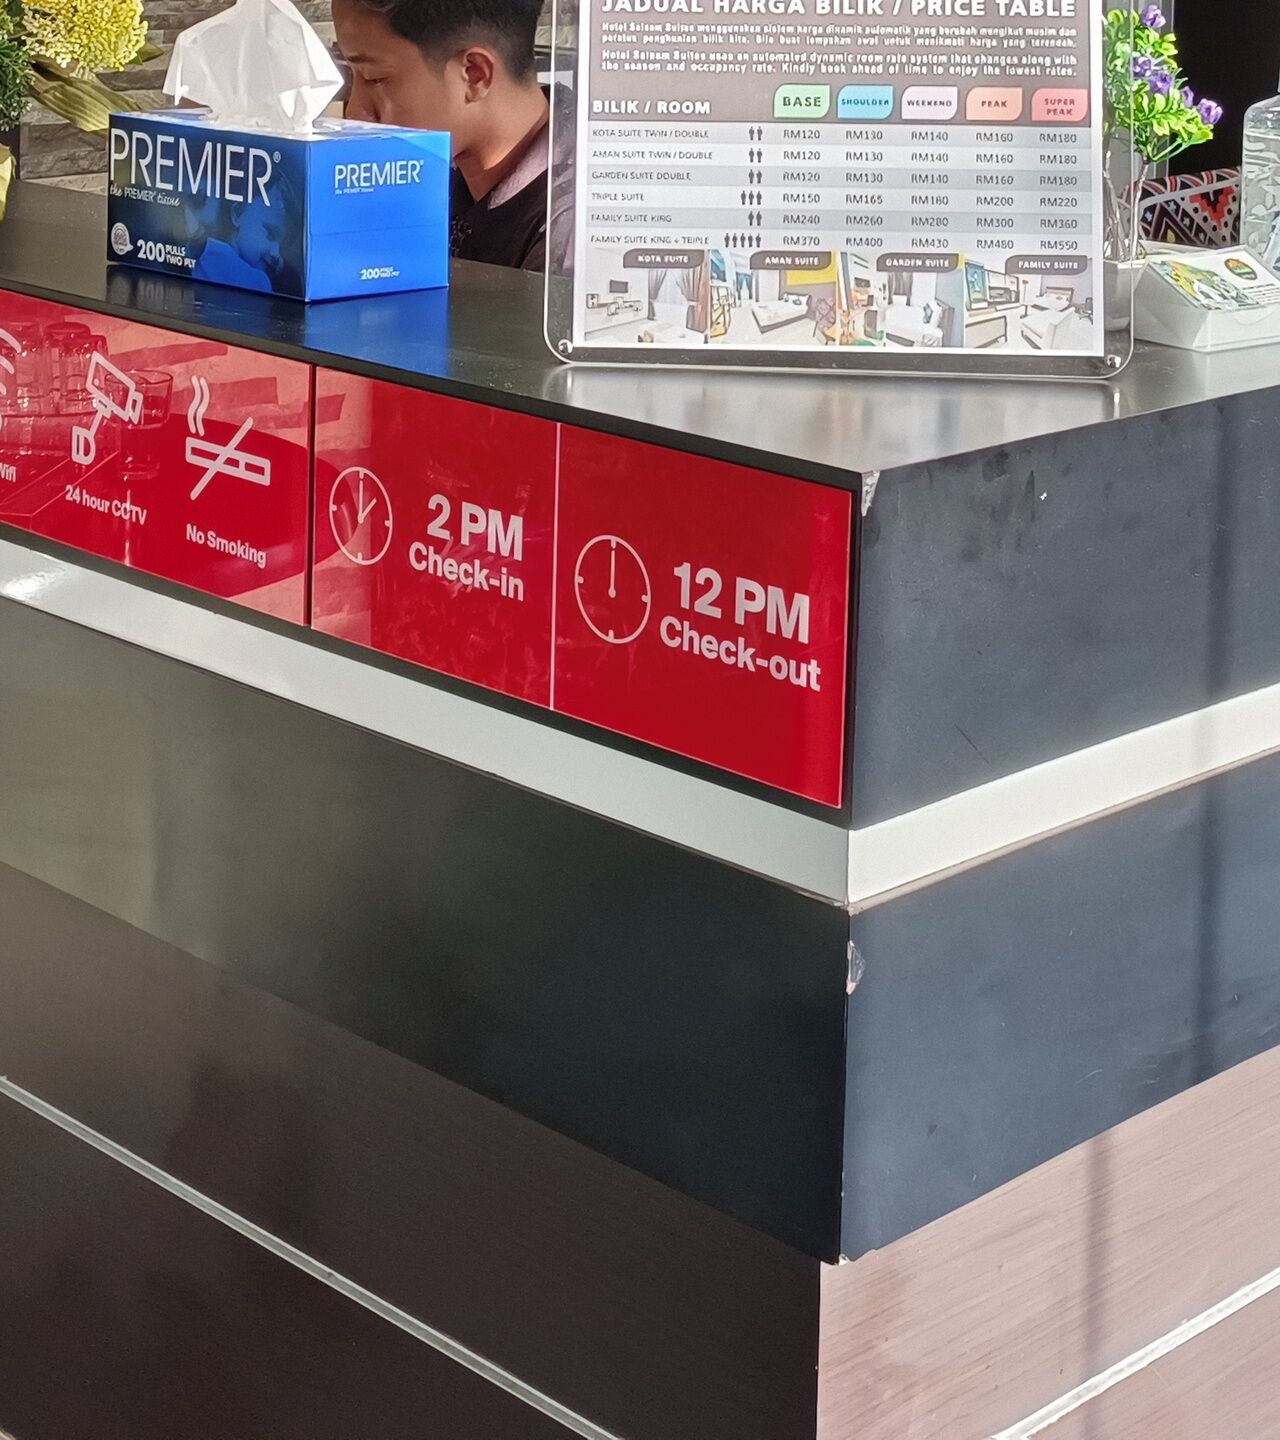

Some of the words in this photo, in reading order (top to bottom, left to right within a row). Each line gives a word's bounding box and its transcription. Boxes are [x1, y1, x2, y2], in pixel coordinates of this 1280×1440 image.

[913, 27, 936, 37] yang
[1058, 26, 1076, 36] dan
[970, 37, 998, 48] harga
[1002, 39, 1026, 48] yang
[810, 52, 853, 64] dynamic
[856, 54, 883, 62] room
[886, 53, 906, 63] rate
[910, 53, 947, 65] system
[950, 54, 972, 63] that
[974, 54, 1018, 66] changes
[1022, 55, 1051, 66] along
[1054, 55, 1077, 64] with
[666, 63, 685, 72] and
[690, 65, 746, 74] occupancy
[782, 64, 815, 75] Kindly
[852, 65, 883, 74] ahead
[888, 65, 900, 74] of
[904, 65, 926, 74] time
[932, 65, 944, 74] to
[948, 67, 978, 76] enjoy
[983, 66, 1000, 75] the
[1006, 66, 1040, 75] lowest
[592, 100, 639, 114] BILIK
[657, 101, 711, 114] ROOM
[783, 96, 822, 107] BASE
[841, 98, 889, 106] SHOULDER
[981, 100, 1007, 108] PEAK
[1044, 98, 1075, 106] SUPER
[1046, 108, 1073, 116] PEAK
[592, 129, 616, 137] KOTA
[645, 129, 667, 138] TWIN
[674, 130, 709, 138] DOUBLE
[784, 130, 820, 139] RM120
[911, 132, 948, 142] RM140
[976, 133, 1014, 142] RM160
[1039, 134, 1078, 143] RM180
[622, 151, 646, 159] SUITE
[649, 151, 671, 159] TWIN
[678, 151, 713, 160] DOUBLE
[784, 151, 820, 160] RM120
[846, 152, 883, 162] RM130
[911, 154, 948, 162] RM140
[976, 154, 1014, 164] RM160
[1039, 155, 1078, 164] RM180
[591, 171, 628, 179] GARDEN
[630, 171, 654, 180] SUITE
[976, 176, 1014, 186] RM160
[1039, 176, 1078, 186] RM180
[620, 193, 644, 201] SUITE
[846, 195, 883, 204] RM165
[976, 197, 1014, 206] RM200
[1039, 198, 1078, 208] RM220
[590, 214, 622, 222] FAMILY
[624, 214, 648, 223] SUITE
[784, 215, 820, 224] RM240
[846, 216, 883, 226] RM260
[976, 218, 1014, 228] RM300
[1039, 220, 1078, 228] RM360
[590, 236, 621, 244] FAMILY
[624, 236, 648, 244] SUITE
[650, 236, 671, 244] KING
[784, 236, 820, 246] RM370
[846, 238, 883, 248] RM400
[911, 239, 948, 248] RM430
[976, 240, 1014, 250] RM480
[1039, 241, 1078, 250] RM550
[137, 239, 165, 262] 200
[165, 245, 186, 256] PULLS
[166, 255, 182, 265] TWO
[183, 258, 196, 268] PLY
[764, 257, 794, 265] AMAN
[885, 259, 922, 267] GARDEN
[925, 259, 949, 268] SUITE
[1018, 261, 1051, 269] FAMILY
[360, 268, 379, 280] 200
[65, 485, 80, 504] 24
[82, 489, 109, 513] hour
[111, 501, 147, 525] CCTV
[427, 494, 451, 540] 2
[461, 501, 523, 560] PM
[186, 523, 205, 545] No
[207, 532, 266, 568] Smoking
[409, 541, 524, 601] Check-in
[673, 562, 722, 619] 12
[734, 577, 810, 644] PM
[660, 615, 821, 692] Check-out
